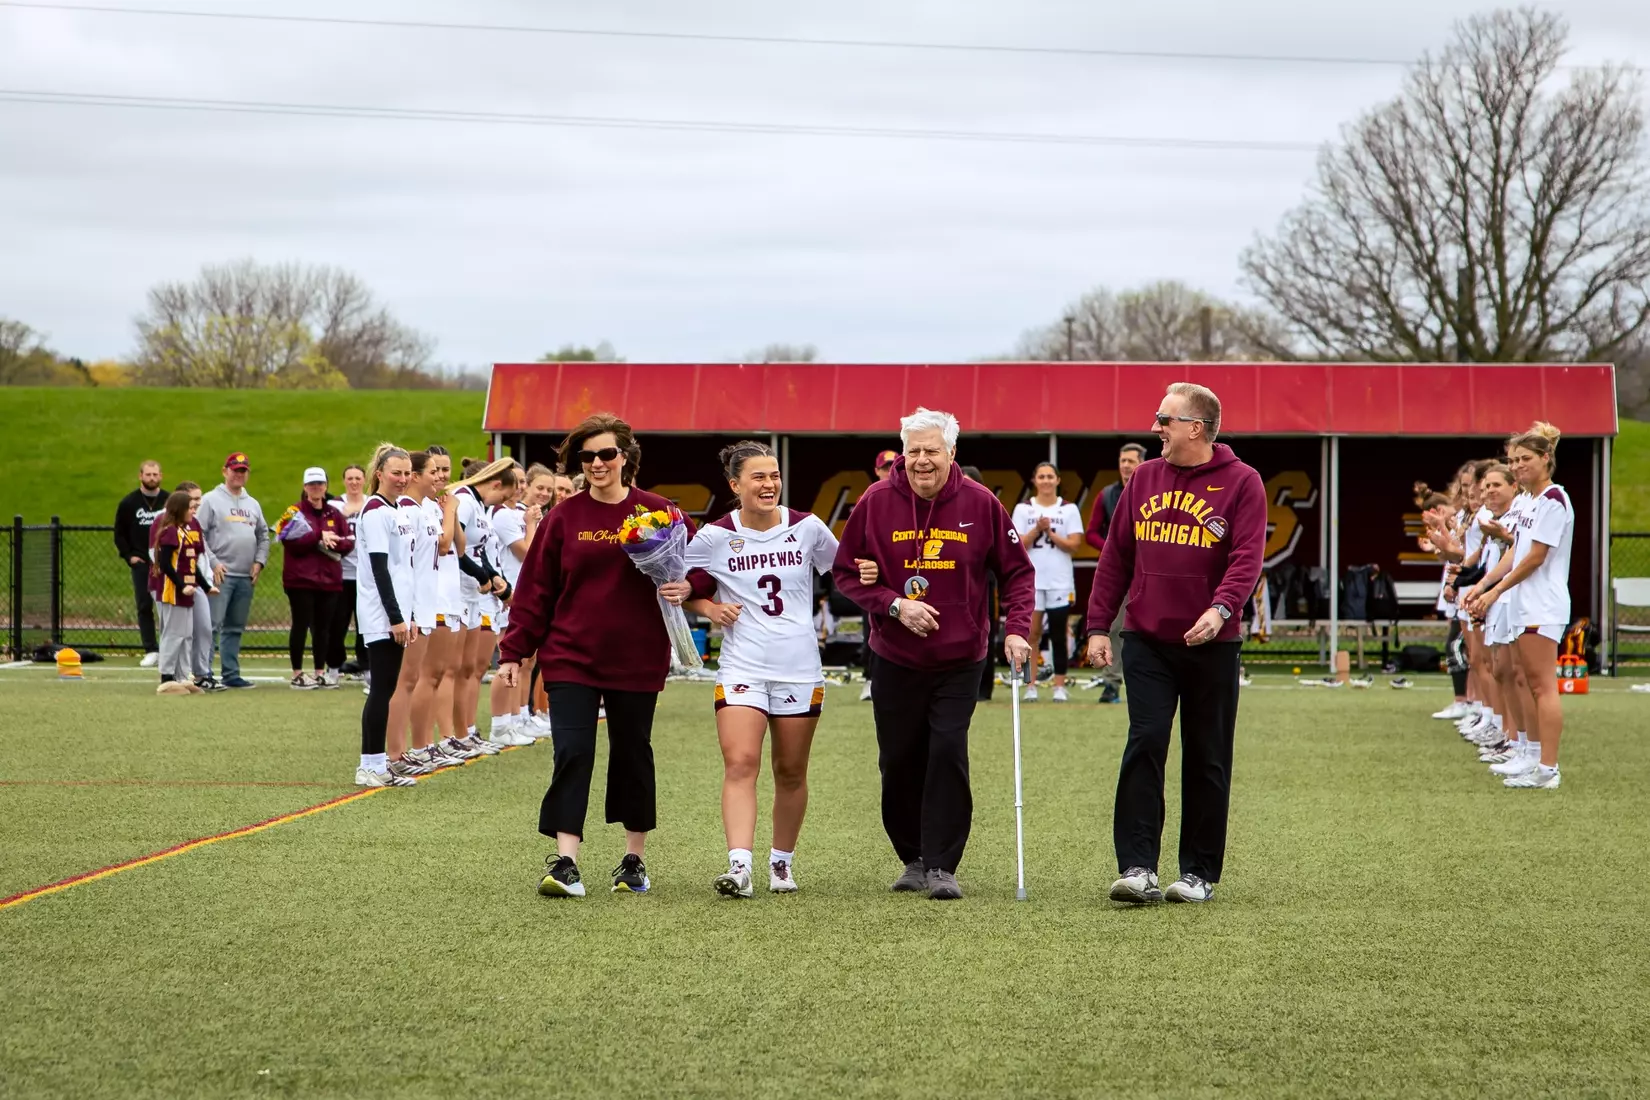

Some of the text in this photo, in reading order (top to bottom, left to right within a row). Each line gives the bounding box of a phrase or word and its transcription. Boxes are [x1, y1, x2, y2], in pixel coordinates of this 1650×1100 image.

[1140, 491, 1213, 525] CENTRAL
[578, 531, 593, 541] CMU
[930, 528, 968, 543] MICHIGAN
[1007, 529, 1020, 544] 3
[728, 550, 803, 572] CHIPPEWAS
[904, 560, 956, 570] LACROSSE
[757, 574, 784, 617] 3
